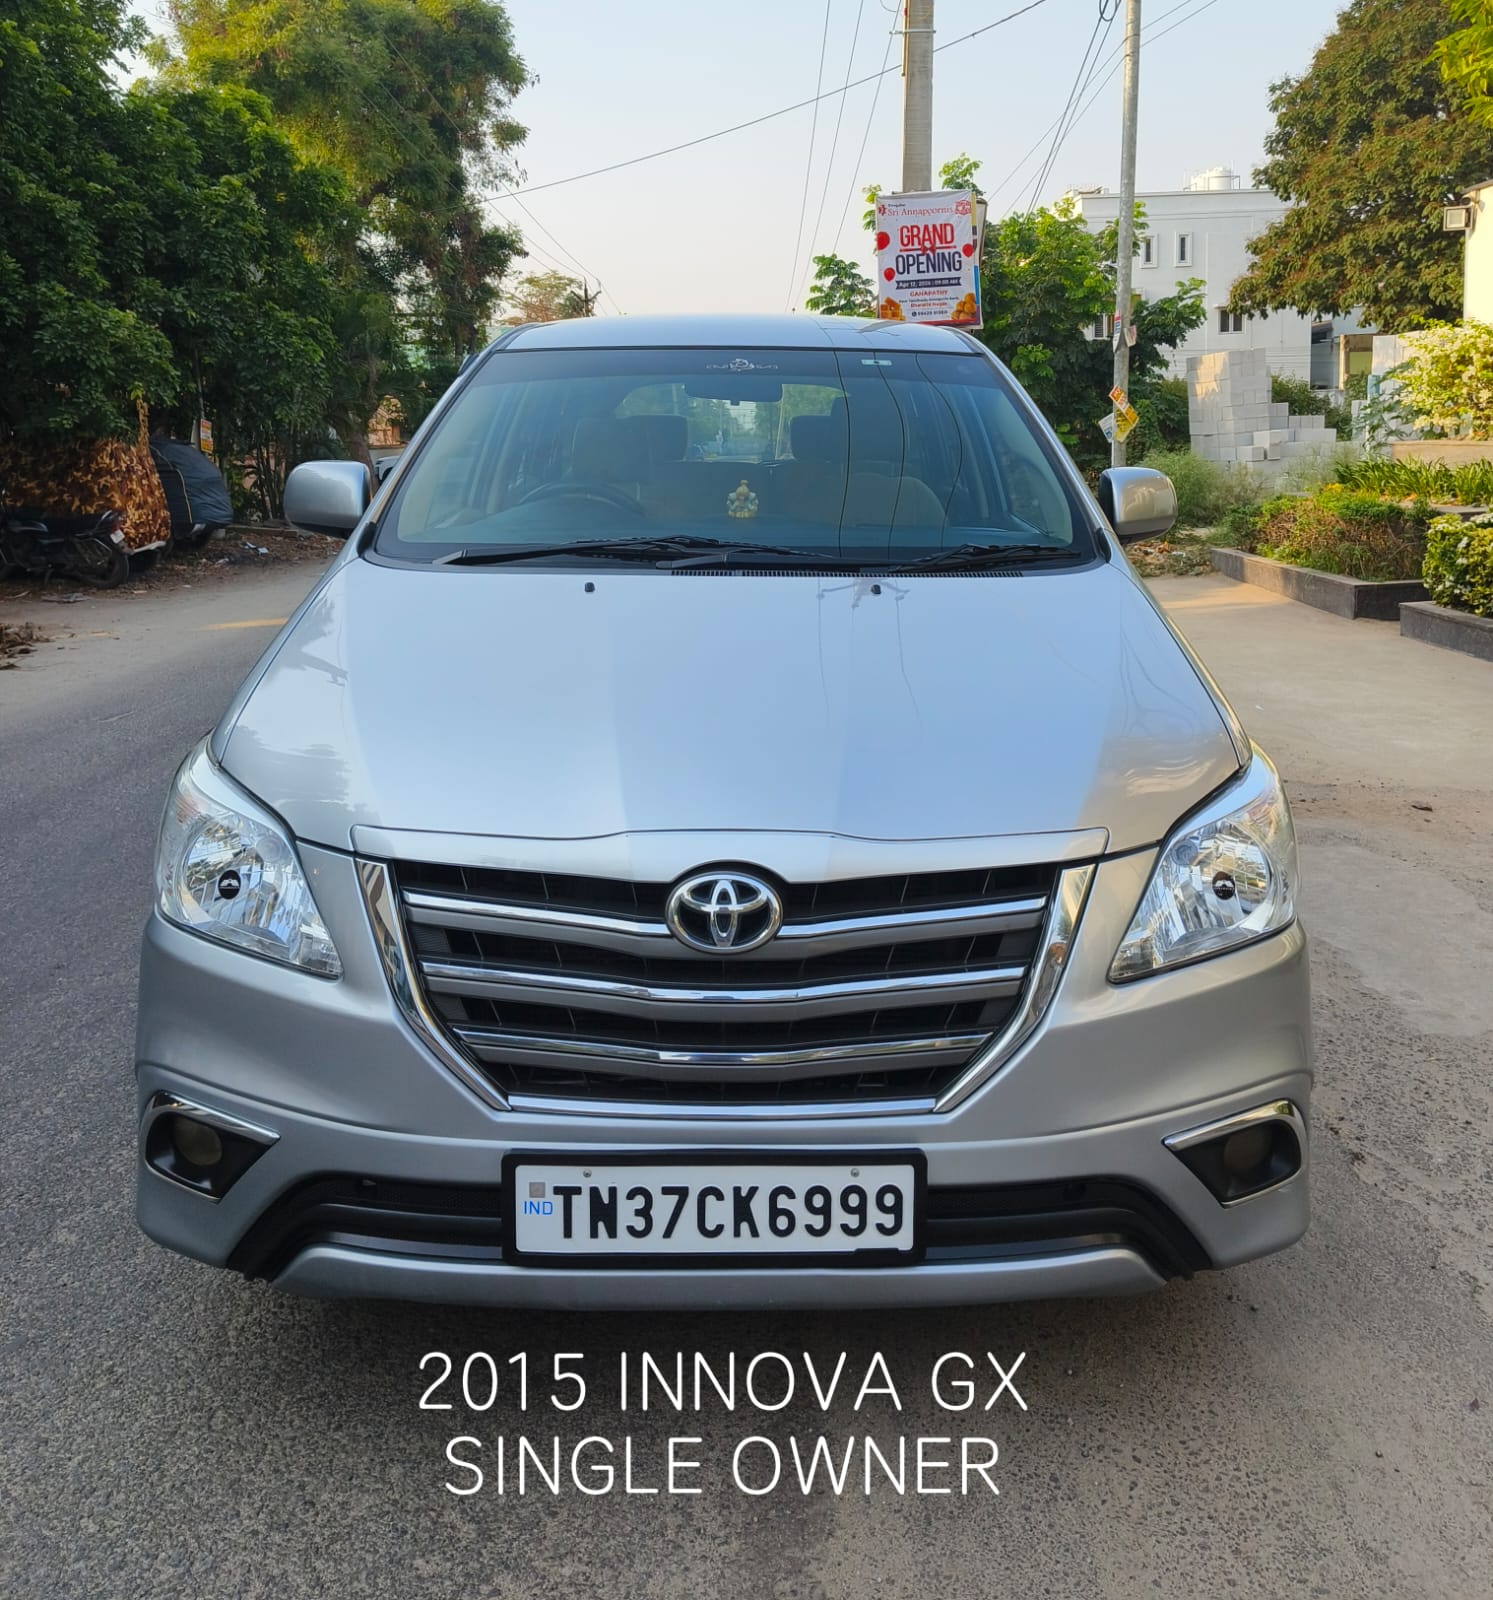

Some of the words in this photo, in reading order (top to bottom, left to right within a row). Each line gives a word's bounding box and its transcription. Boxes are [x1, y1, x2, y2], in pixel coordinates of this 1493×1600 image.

[900, 223, 954, 247] GRAND
[896, 251, 962, 275] OPENING
[523, 1200, 553, 1216] IND
[553, 1184, 904, 1239] TN37CK6999
